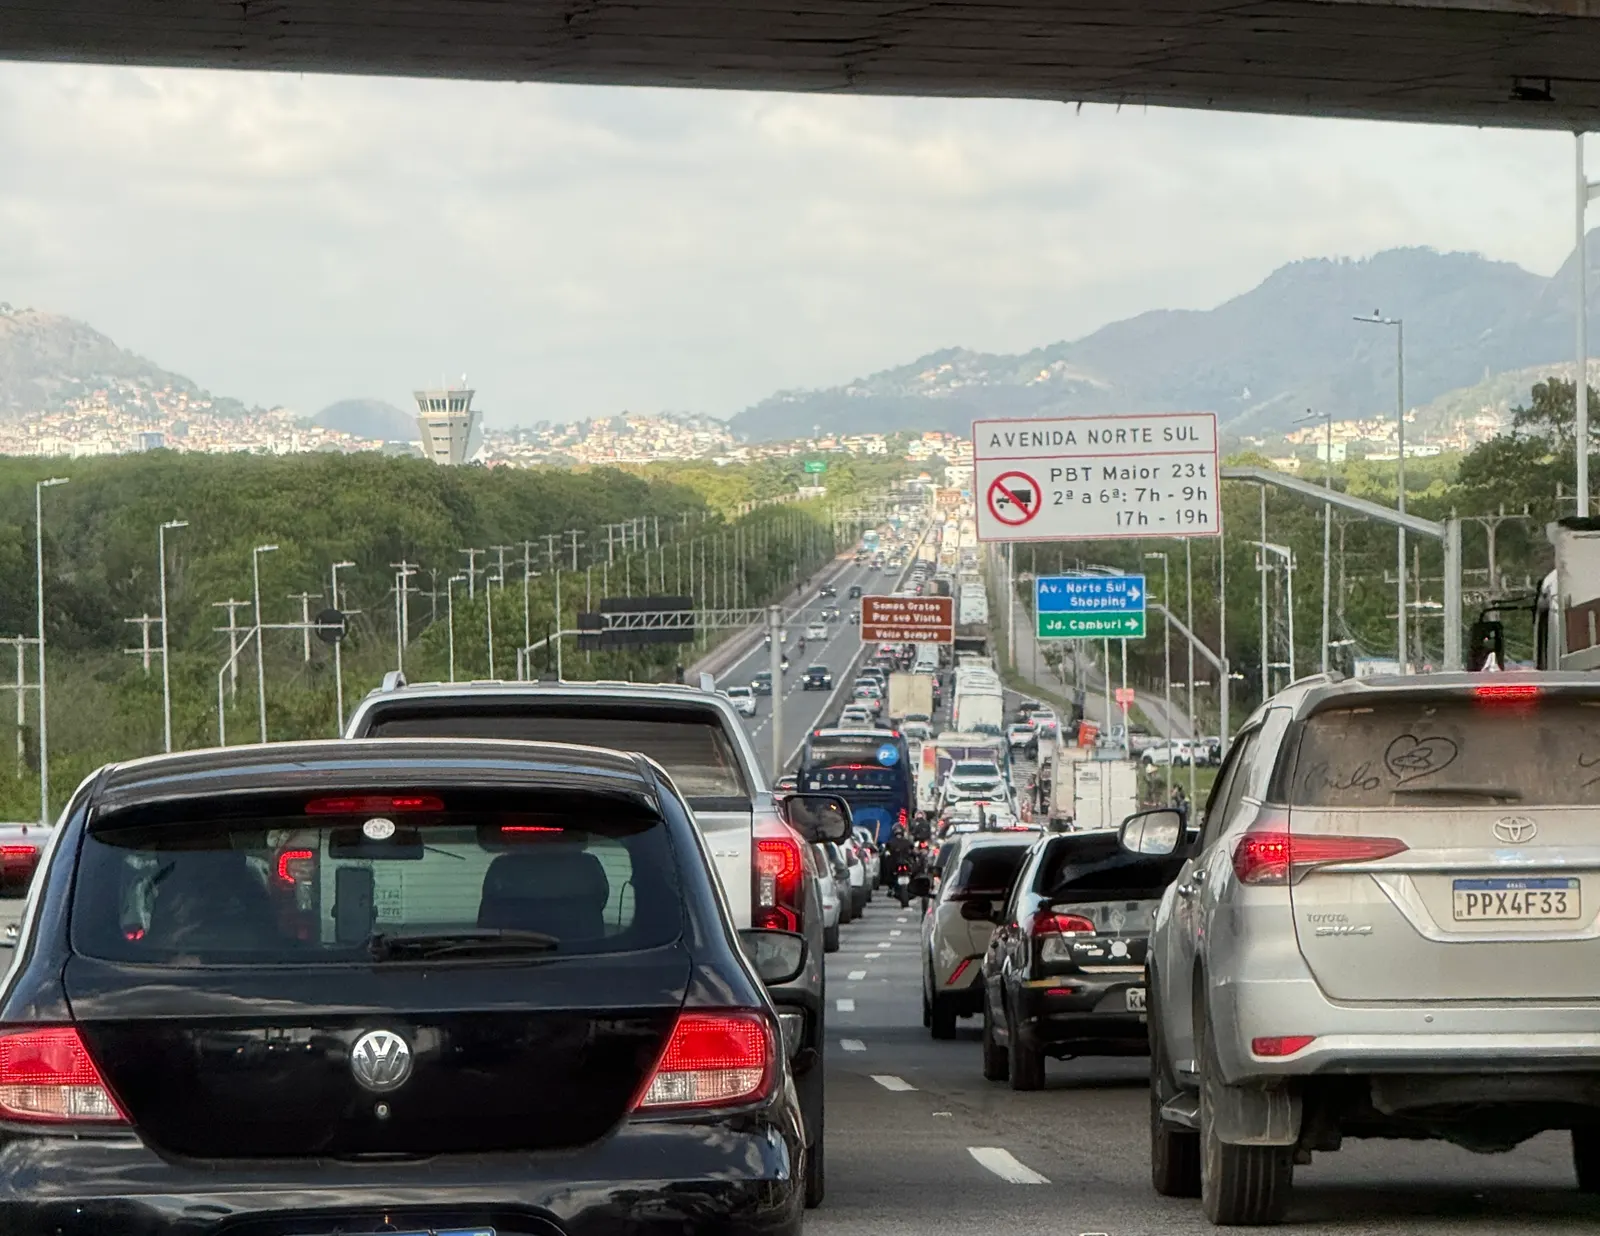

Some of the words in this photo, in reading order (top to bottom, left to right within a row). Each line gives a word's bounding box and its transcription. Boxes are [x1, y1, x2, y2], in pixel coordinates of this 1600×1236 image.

[989, 430, 1077, 448] AVENIDA
[1087, 428, 1153, 444] NORTE
[1163, 426, 1199, 442] SUL
[1050, 466, 1092, 482] PBT
[1103, 465, 1161, 480] Maior
[1171, 463, 1207, 478] 23t
[1053, 490, 1074, 505] 2ª
[1081, 492, 1092, 504] a
[1134, 487, 1160, 502] 7h
[1182, 486, 1207, 501] 9h
[1116, 511, 1148, 526] 17h
[1176, 509, 1208, 524] 19h
[1039, 582, 1062, 593] Av.
[1066, 582, 1102, 593] Norte
[1105, 581, 1126, 593] Sul
[1070, 595, 1127, 608] Shopping
[1046, 619, 1066, 630] Jd.
[1069, 619, 1122, 630] Camburi
[1465, 891, 1568, 916] PPX4F33
[1307, 912, 1349, 923] TOYOTA
